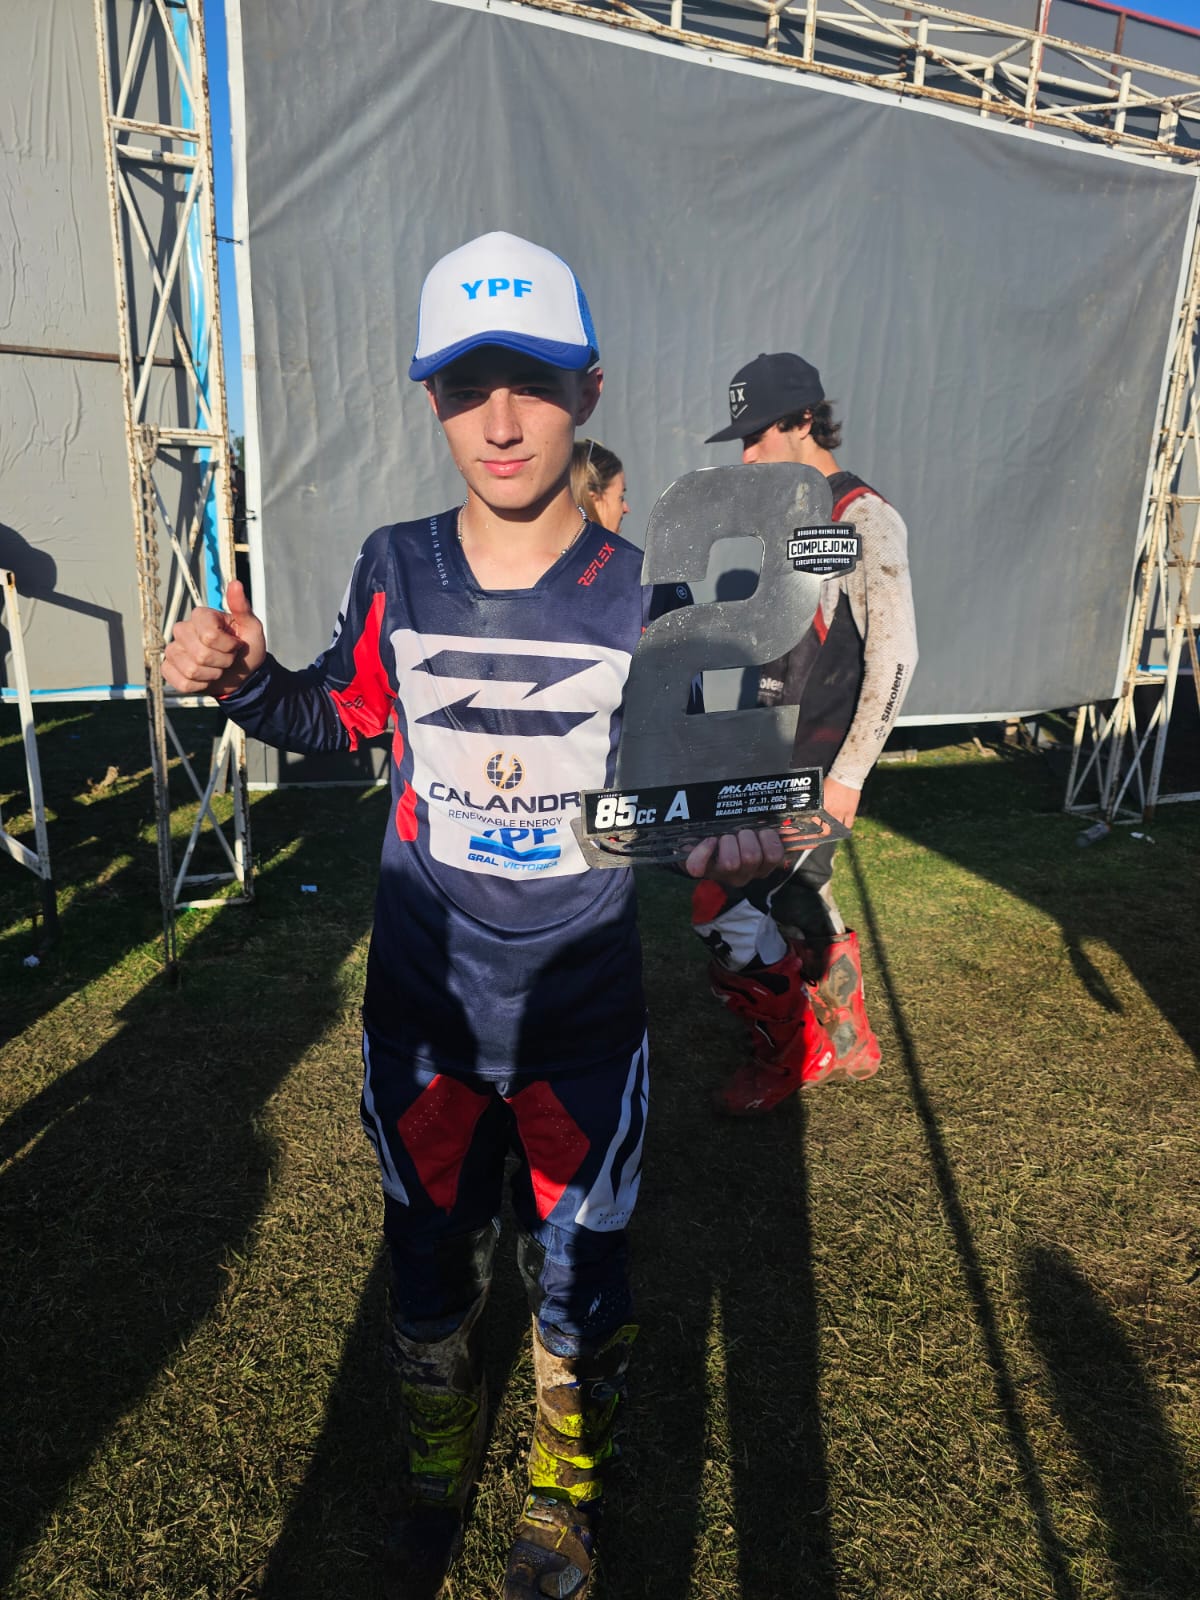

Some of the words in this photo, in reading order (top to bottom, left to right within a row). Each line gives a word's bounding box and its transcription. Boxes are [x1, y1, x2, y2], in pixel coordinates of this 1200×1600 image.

[461, 278, 532, 299] YPF
[577, 541, 615, 586] REFLEX
[881, 663, 905, 723] Silkolene
[743, 777, 812, 793] ARGENTINO
[664, 790, 691, 823] A
[448, 809, 516, 828] RENEWABLE
[519, 816, 563, 828] ENERGY
[467, 852, 499, 867] GRAL
